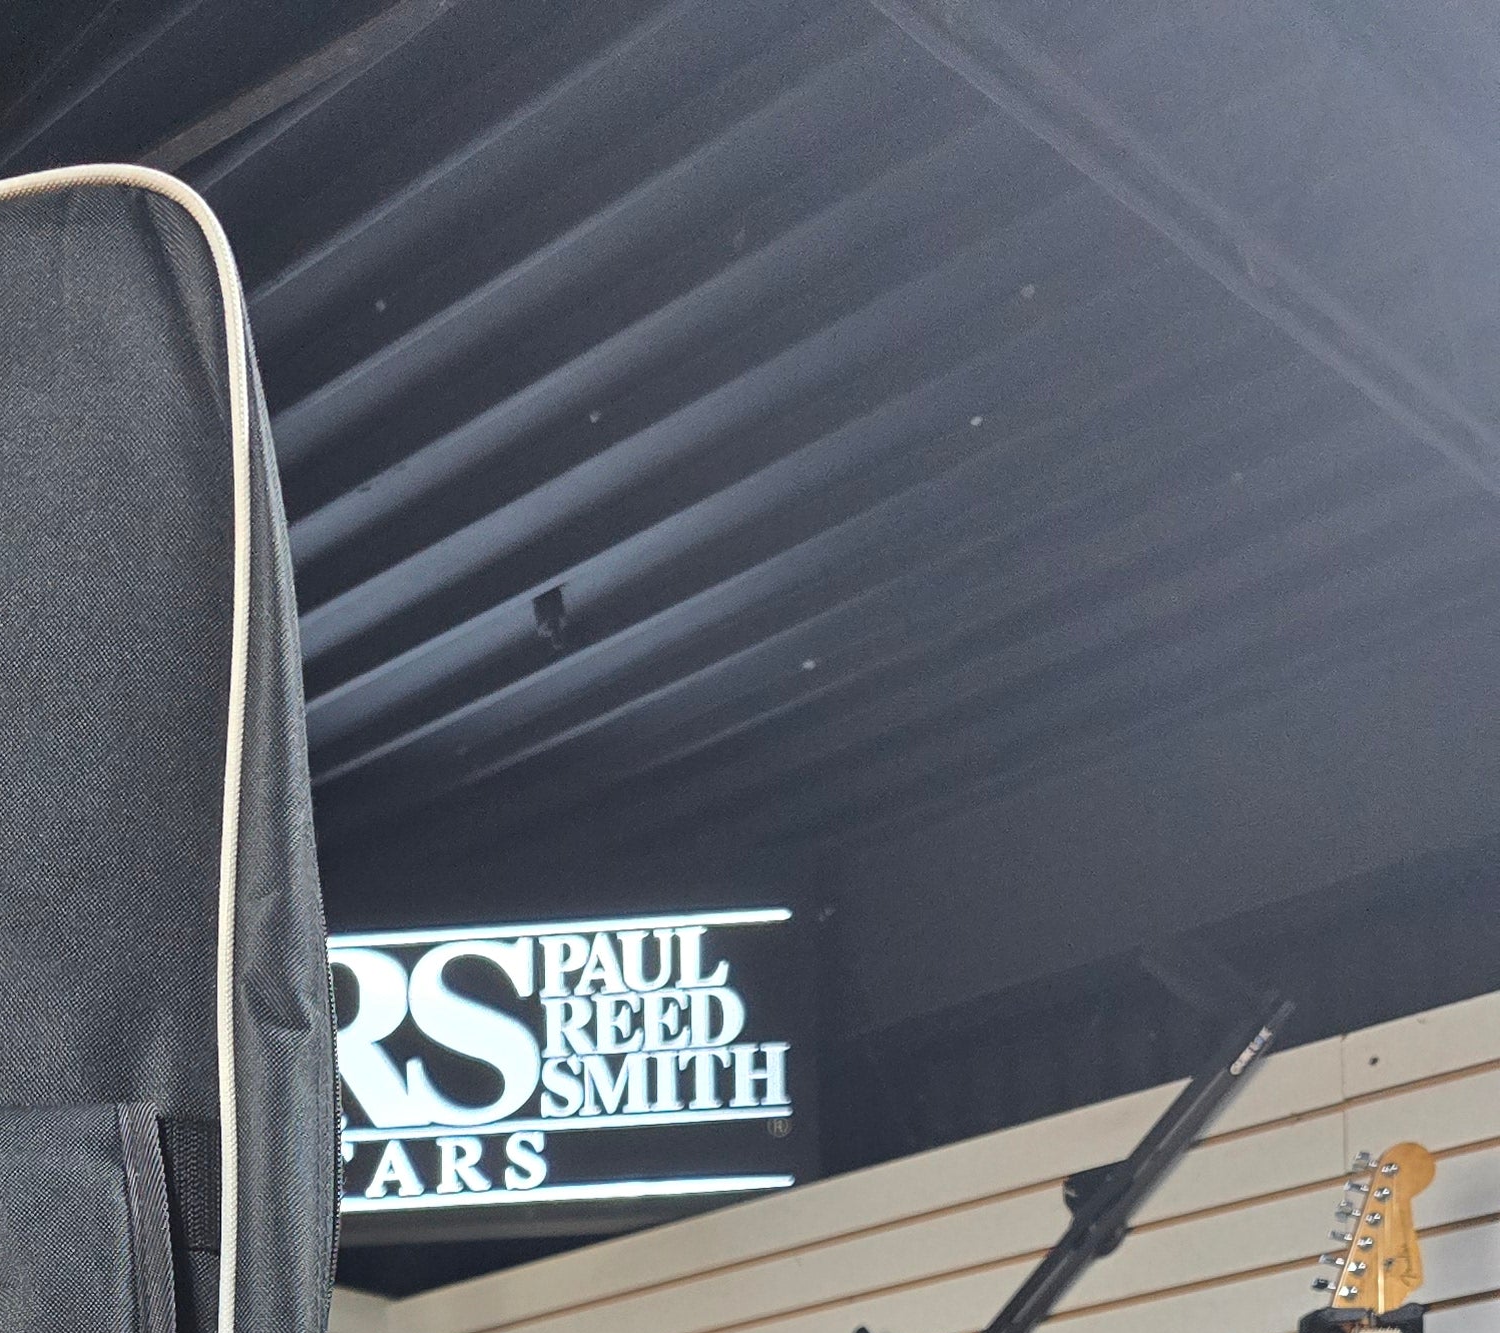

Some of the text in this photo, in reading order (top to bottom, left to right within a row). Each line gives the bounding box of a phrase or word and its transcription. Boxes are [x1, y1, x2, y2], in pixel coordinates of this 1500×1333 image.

[538, 926, 729, 998] PAUL
[328, 938, 542, 1128] RS
[541, 986, 746, 1058] REED
[540, 1042, 791, 1118] SMITH
